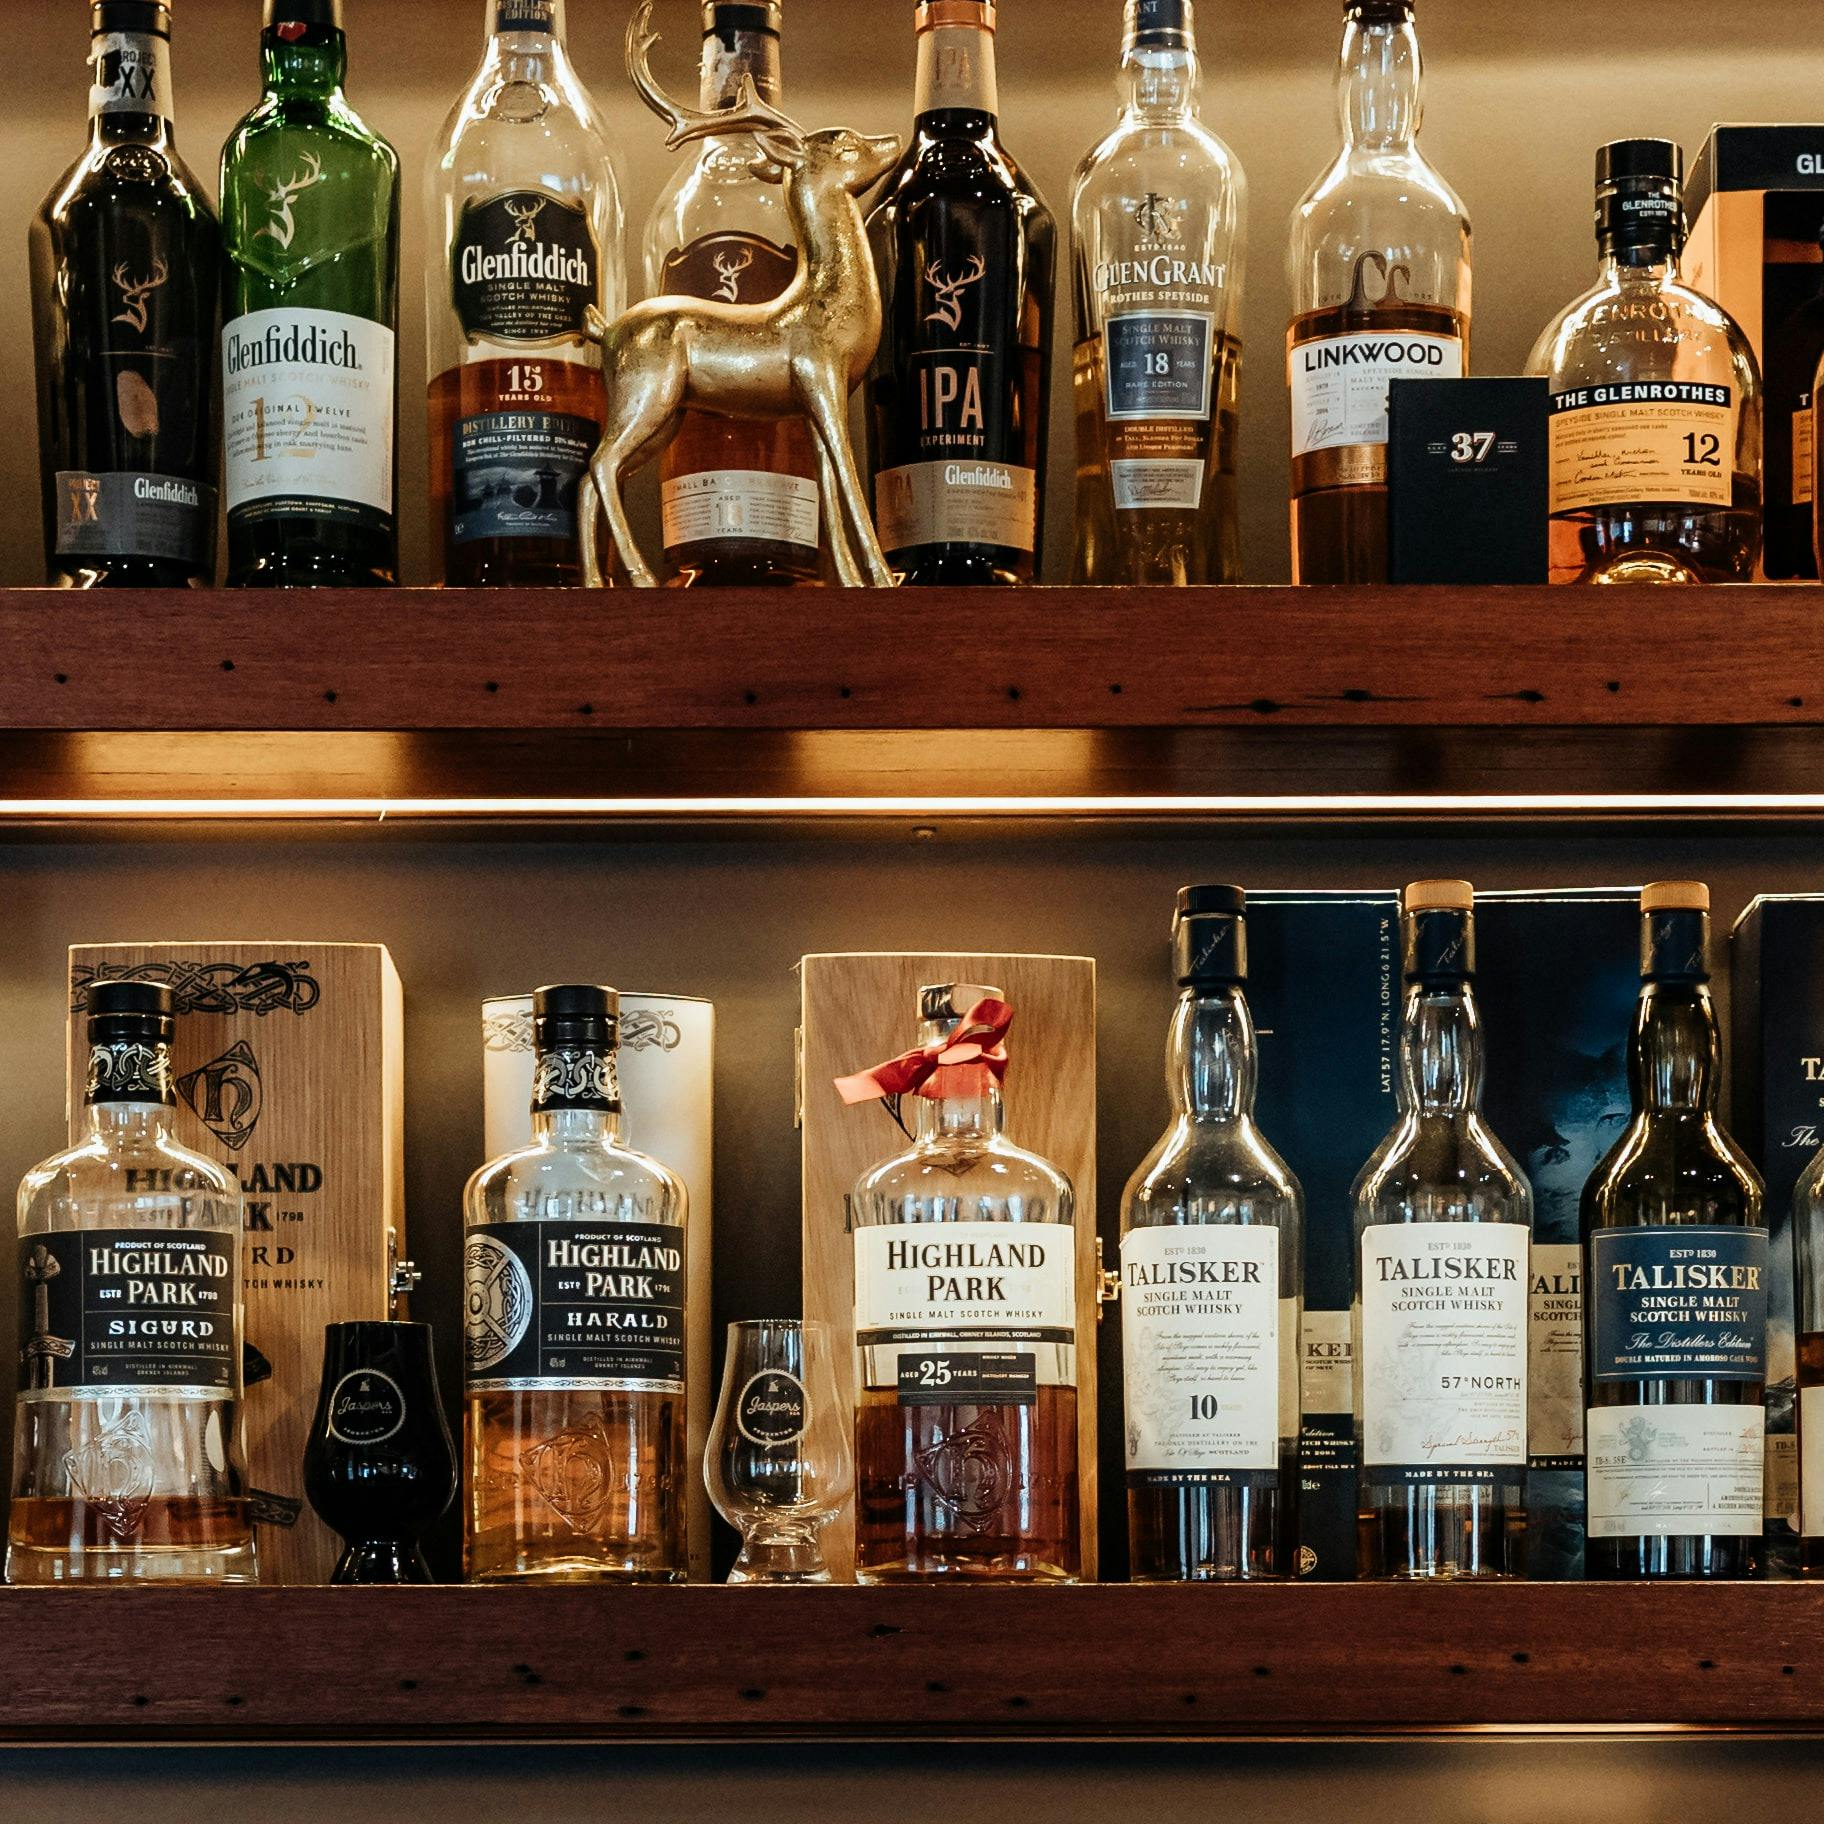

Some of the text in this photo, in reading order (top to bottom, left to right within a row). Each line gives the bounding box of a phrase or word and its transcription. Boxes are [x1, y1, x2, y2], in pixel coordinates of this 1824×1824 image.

[462, 242, 590, 286] Glenfiddich
[1109, 291, 1209, 304] ROTHES SPEYSIDE
[227, 324, 361, 377] Glenfiddich
[1304, 343, 1444, 372] LINKWOOD
[919, 366, 984, 432] IPA
[1556, 383, 1726, 409] THE GLENROTHES
[1451, 432, 1495, 463] 37
[1683, 432, 1720, 465] 12
[945, 464, 1013, 489] Glenfiddich
[134, 476, 198, 506] Glenfiddich
[89, 1250, 227, 1278] HIGHLAND
[547, 1240, 679, 1272] HIGHLAND
[887, 1239, 1046, 1272] HIGHLAND
[1376, 1257, 1517, 1282] TALISKER
[586, 1274, 654, 1299] PARK
[927, 1275, 1006, 1302] PARK
[1128, 1262, 1259, 1287] TALISKER
[1613, 1262, 1760, 1292] TALISKER
[128, 1281, 195, 1306] PARK
[109, 1319, 213, 1337] SIGURD
[567, 1312, 669, 1330] HARALD
